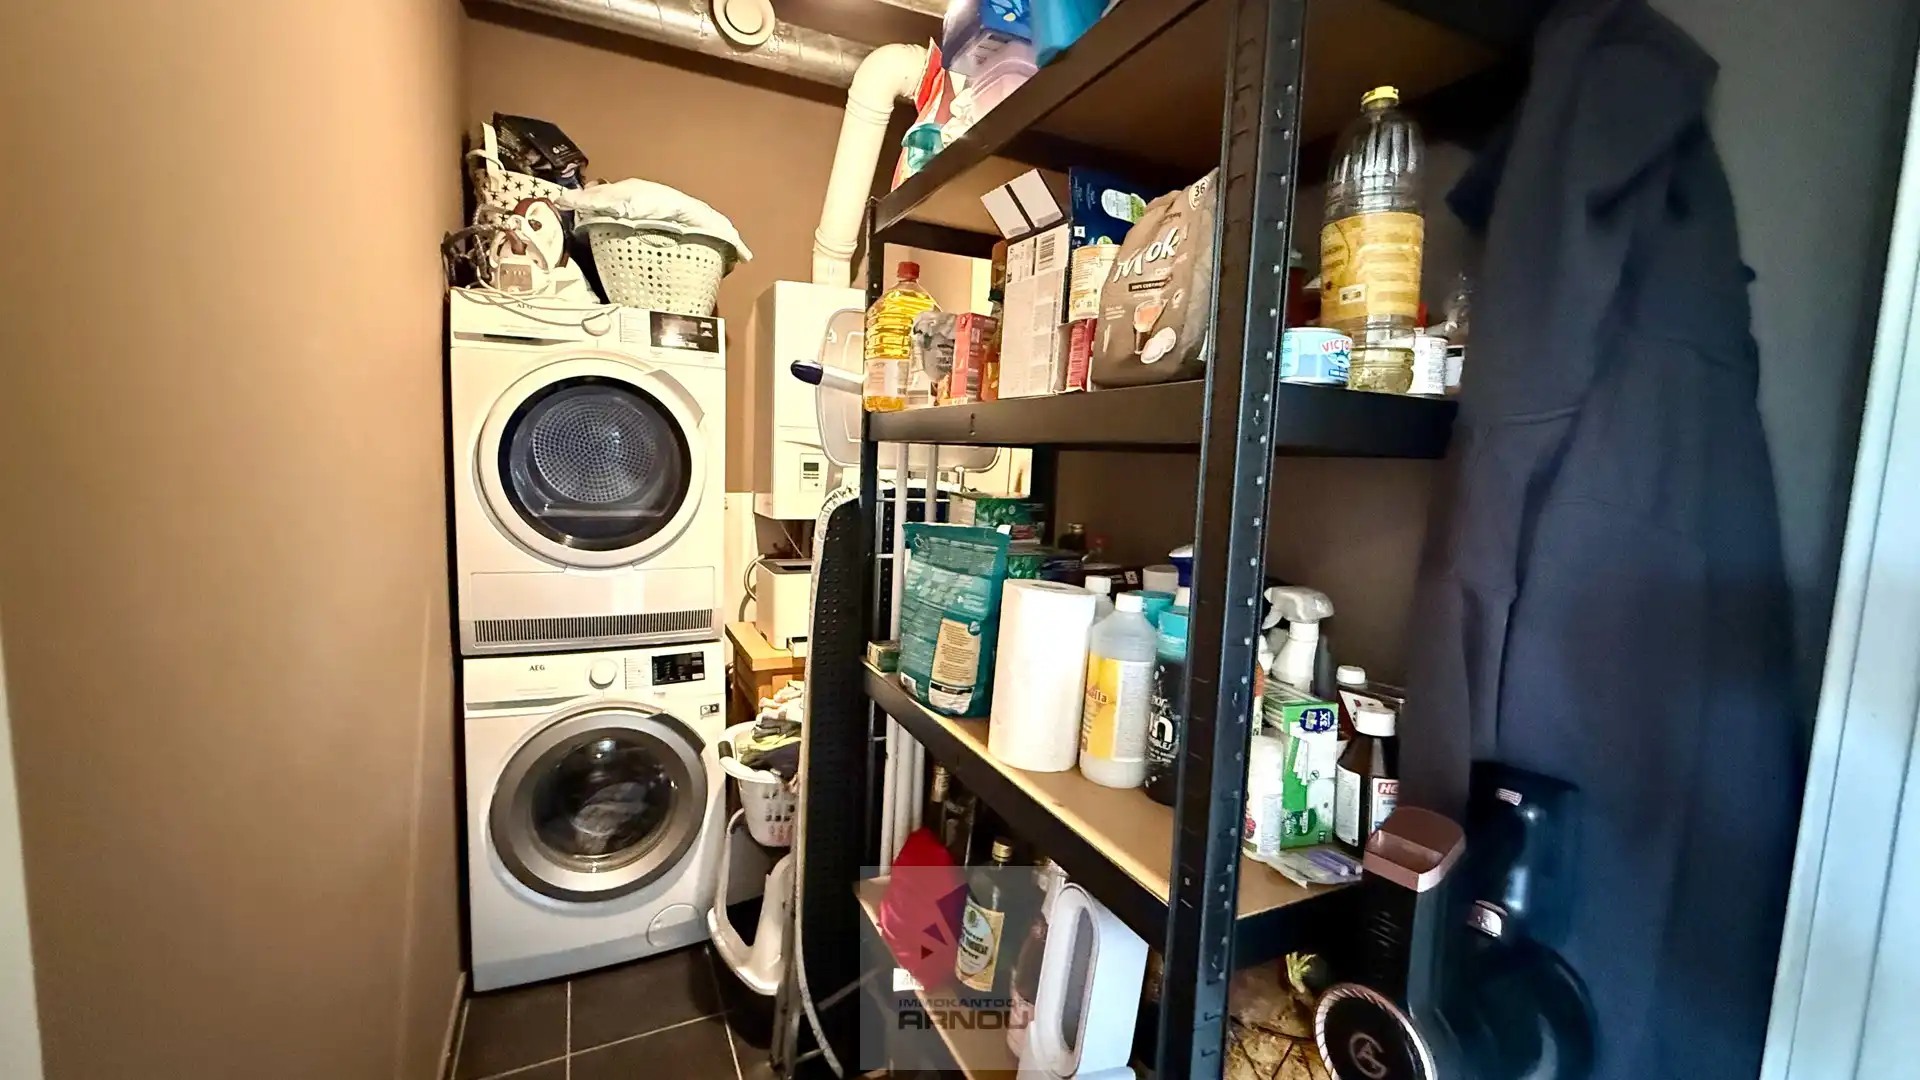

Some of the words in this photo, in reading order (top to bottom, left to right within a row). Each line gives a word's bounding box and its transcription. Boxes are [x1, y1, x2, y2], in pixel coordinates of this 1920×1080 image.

[1194, 182, 1206, 197] 36
[1321, 339, 1350, 352] VICTO
[529, 664, 546, 672] AEG
